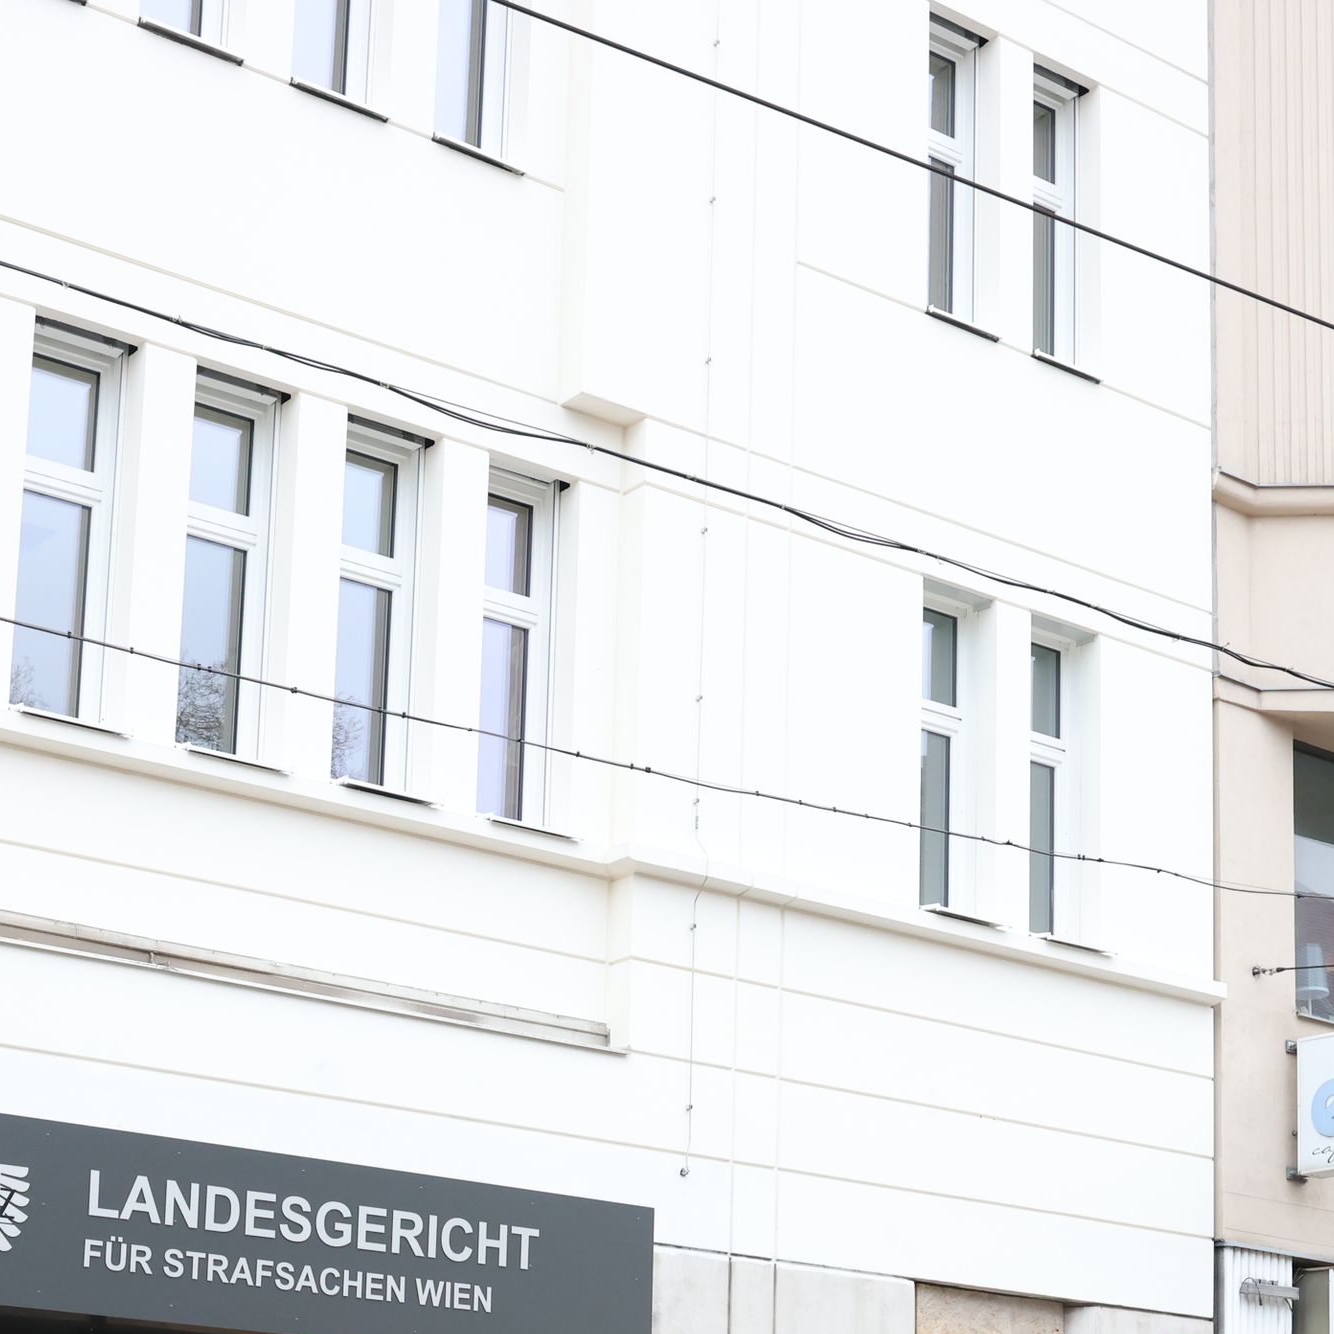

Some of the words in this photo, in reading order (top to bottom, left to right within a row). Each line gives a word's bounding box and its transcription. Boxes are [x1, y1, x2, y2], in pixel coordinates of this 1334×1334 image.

[87, 1169, 541, 1271] LANDESGERICHT
[82, 1236, 154, 1276] FÜR
[162, 1247, 406, 1304] STRAFSACHEN
[415, 1277, 493, 1314] WIEN
